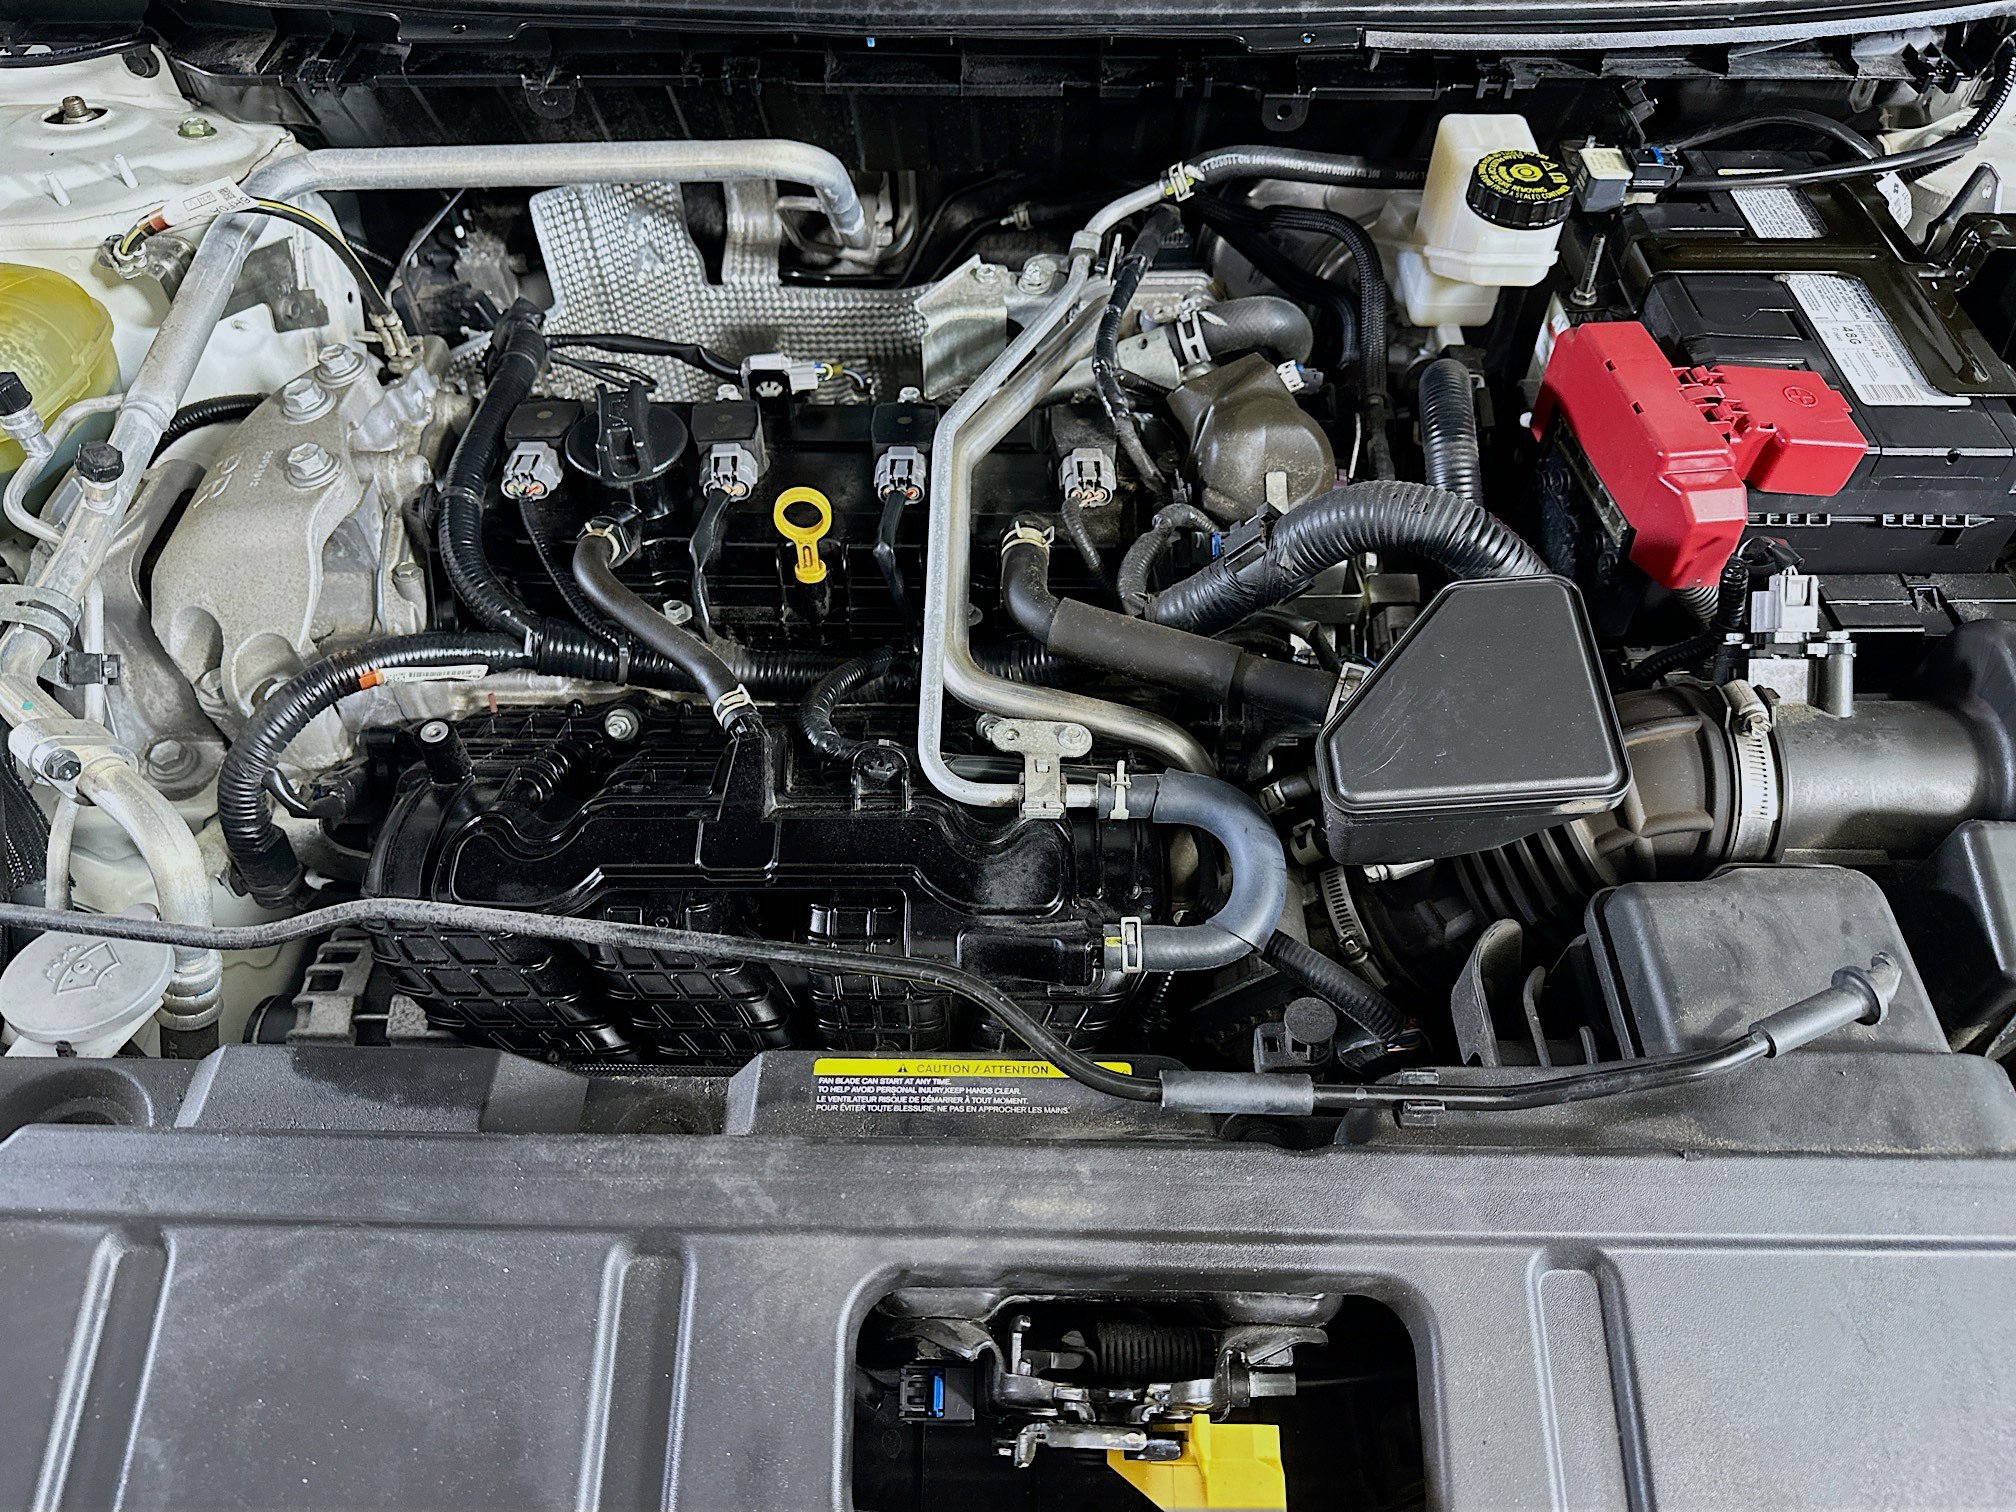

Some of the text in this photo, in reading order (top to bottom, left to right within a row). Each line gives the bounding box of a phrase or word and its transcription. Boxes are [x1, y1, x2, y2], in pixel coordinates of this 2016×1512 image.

[1491, 184, 1509, 195] FROM
[1515, 191, 1541, 200] SEALED
[1842, 325, 1861, 345] 48G
[916, 1064, 970, 1074] CAUTION
[983, 1065, 1049, 1075] ATTENTION
[818, 1077, 834, 1085] FAN
[834, 1077, 861, 1085] BLADE
[861, 1077, 878, 1085] CAN
[879, 1077, 904, 1085] START
[876, 1086, 917, 1094] PERSONAL
[993, 1087, 1021, 1095] CLEAR.
[816, 1094, 1029, 1105] LE VENTILATEUR RISQUE DE DÉMARRER À TOUT MOMENT.
[815, 1104, 839, 1112] POUR
[839, 1103, 866, 1112] ÉVITER
[867, 1104, 893, 1112] TOUTE
[893, 1105, 936, 1113] BLESSURE,
[949, 1105, 965, 1113] PAS
[965, 1105, 977, 1113] EN
[978, 1105, 1027, 1113] APPROCHER
[1027, 1106, 1043, 1114] LES
[1043, 1106, 1070, 1114] MAINS.
